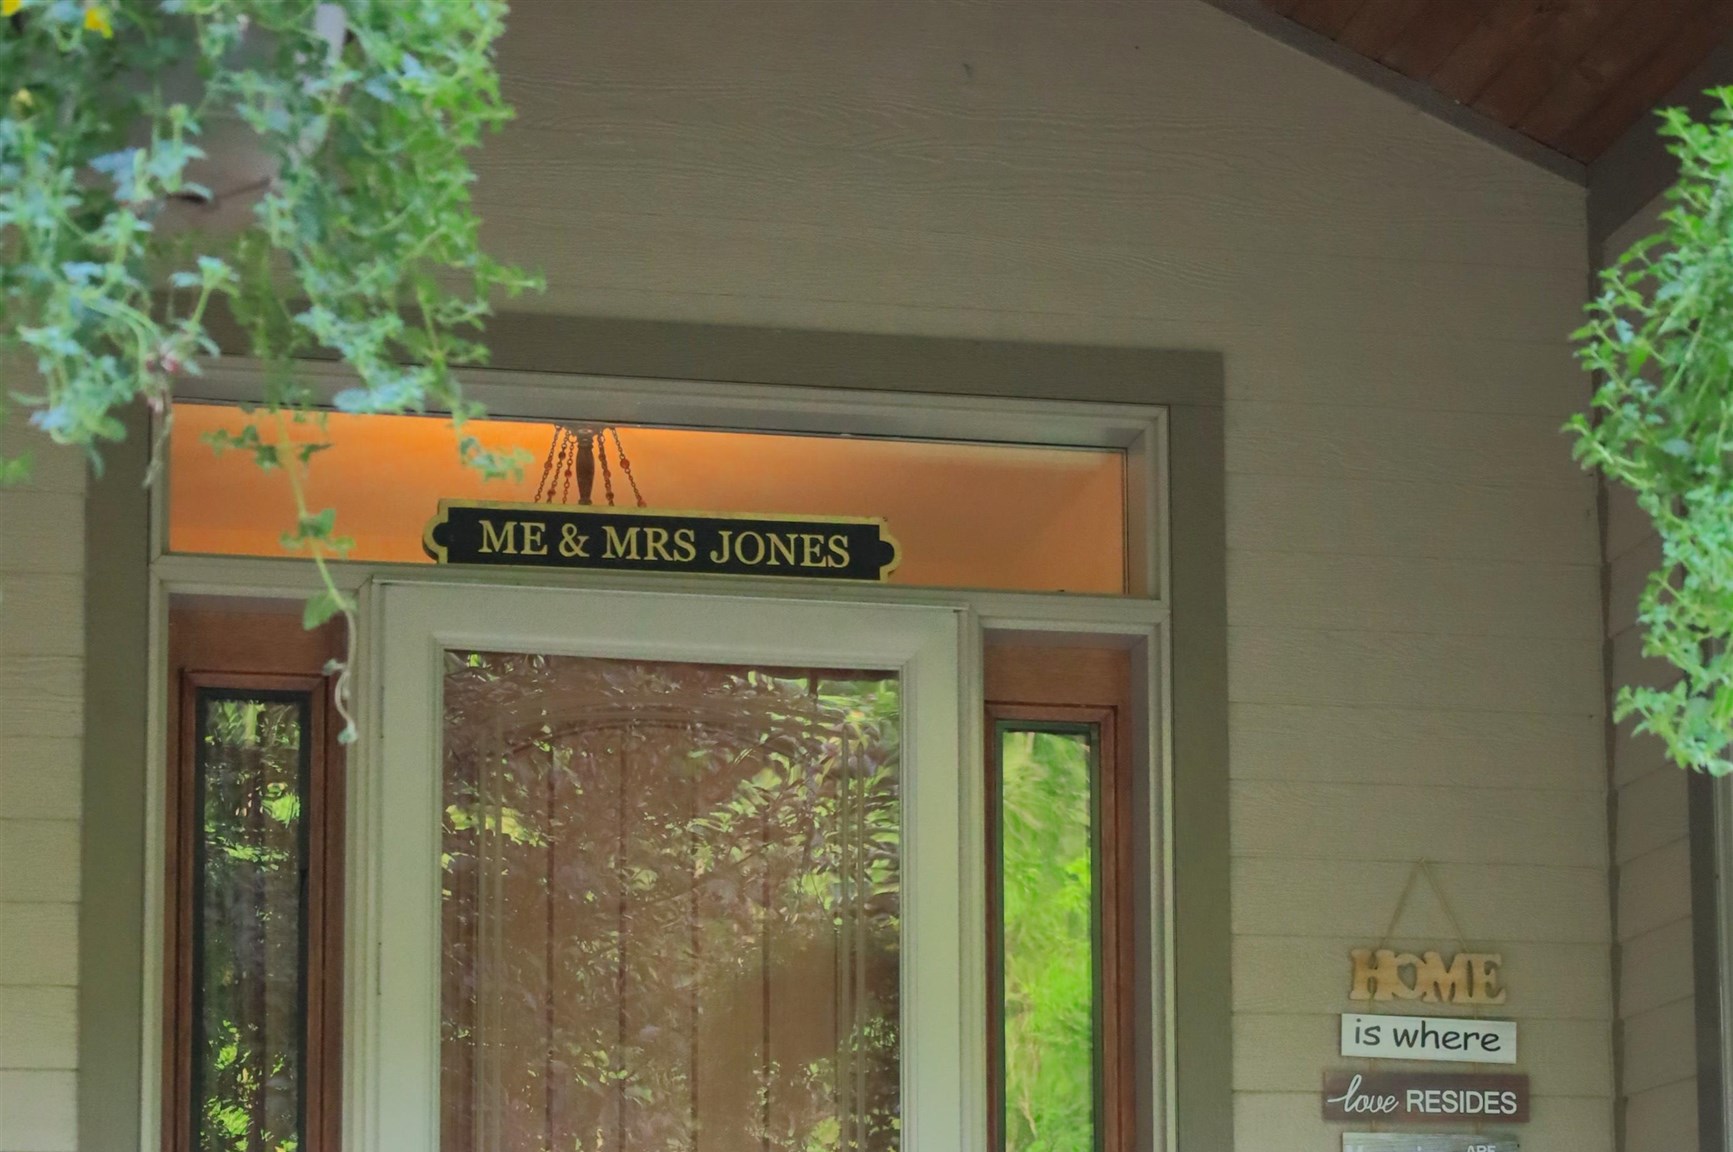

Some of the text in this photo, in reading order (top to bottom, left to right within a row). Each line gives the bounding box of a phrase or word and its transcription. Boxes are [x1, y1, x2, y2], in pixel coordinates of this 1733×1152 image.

[478, 519, 851, 568] ME & MRS JONES
[1349, 949, 1506, 1004] HOME
[1355, 1018, 1501, 1052] is where
[1327, 1074, 1517, 1114] love RESIDES
